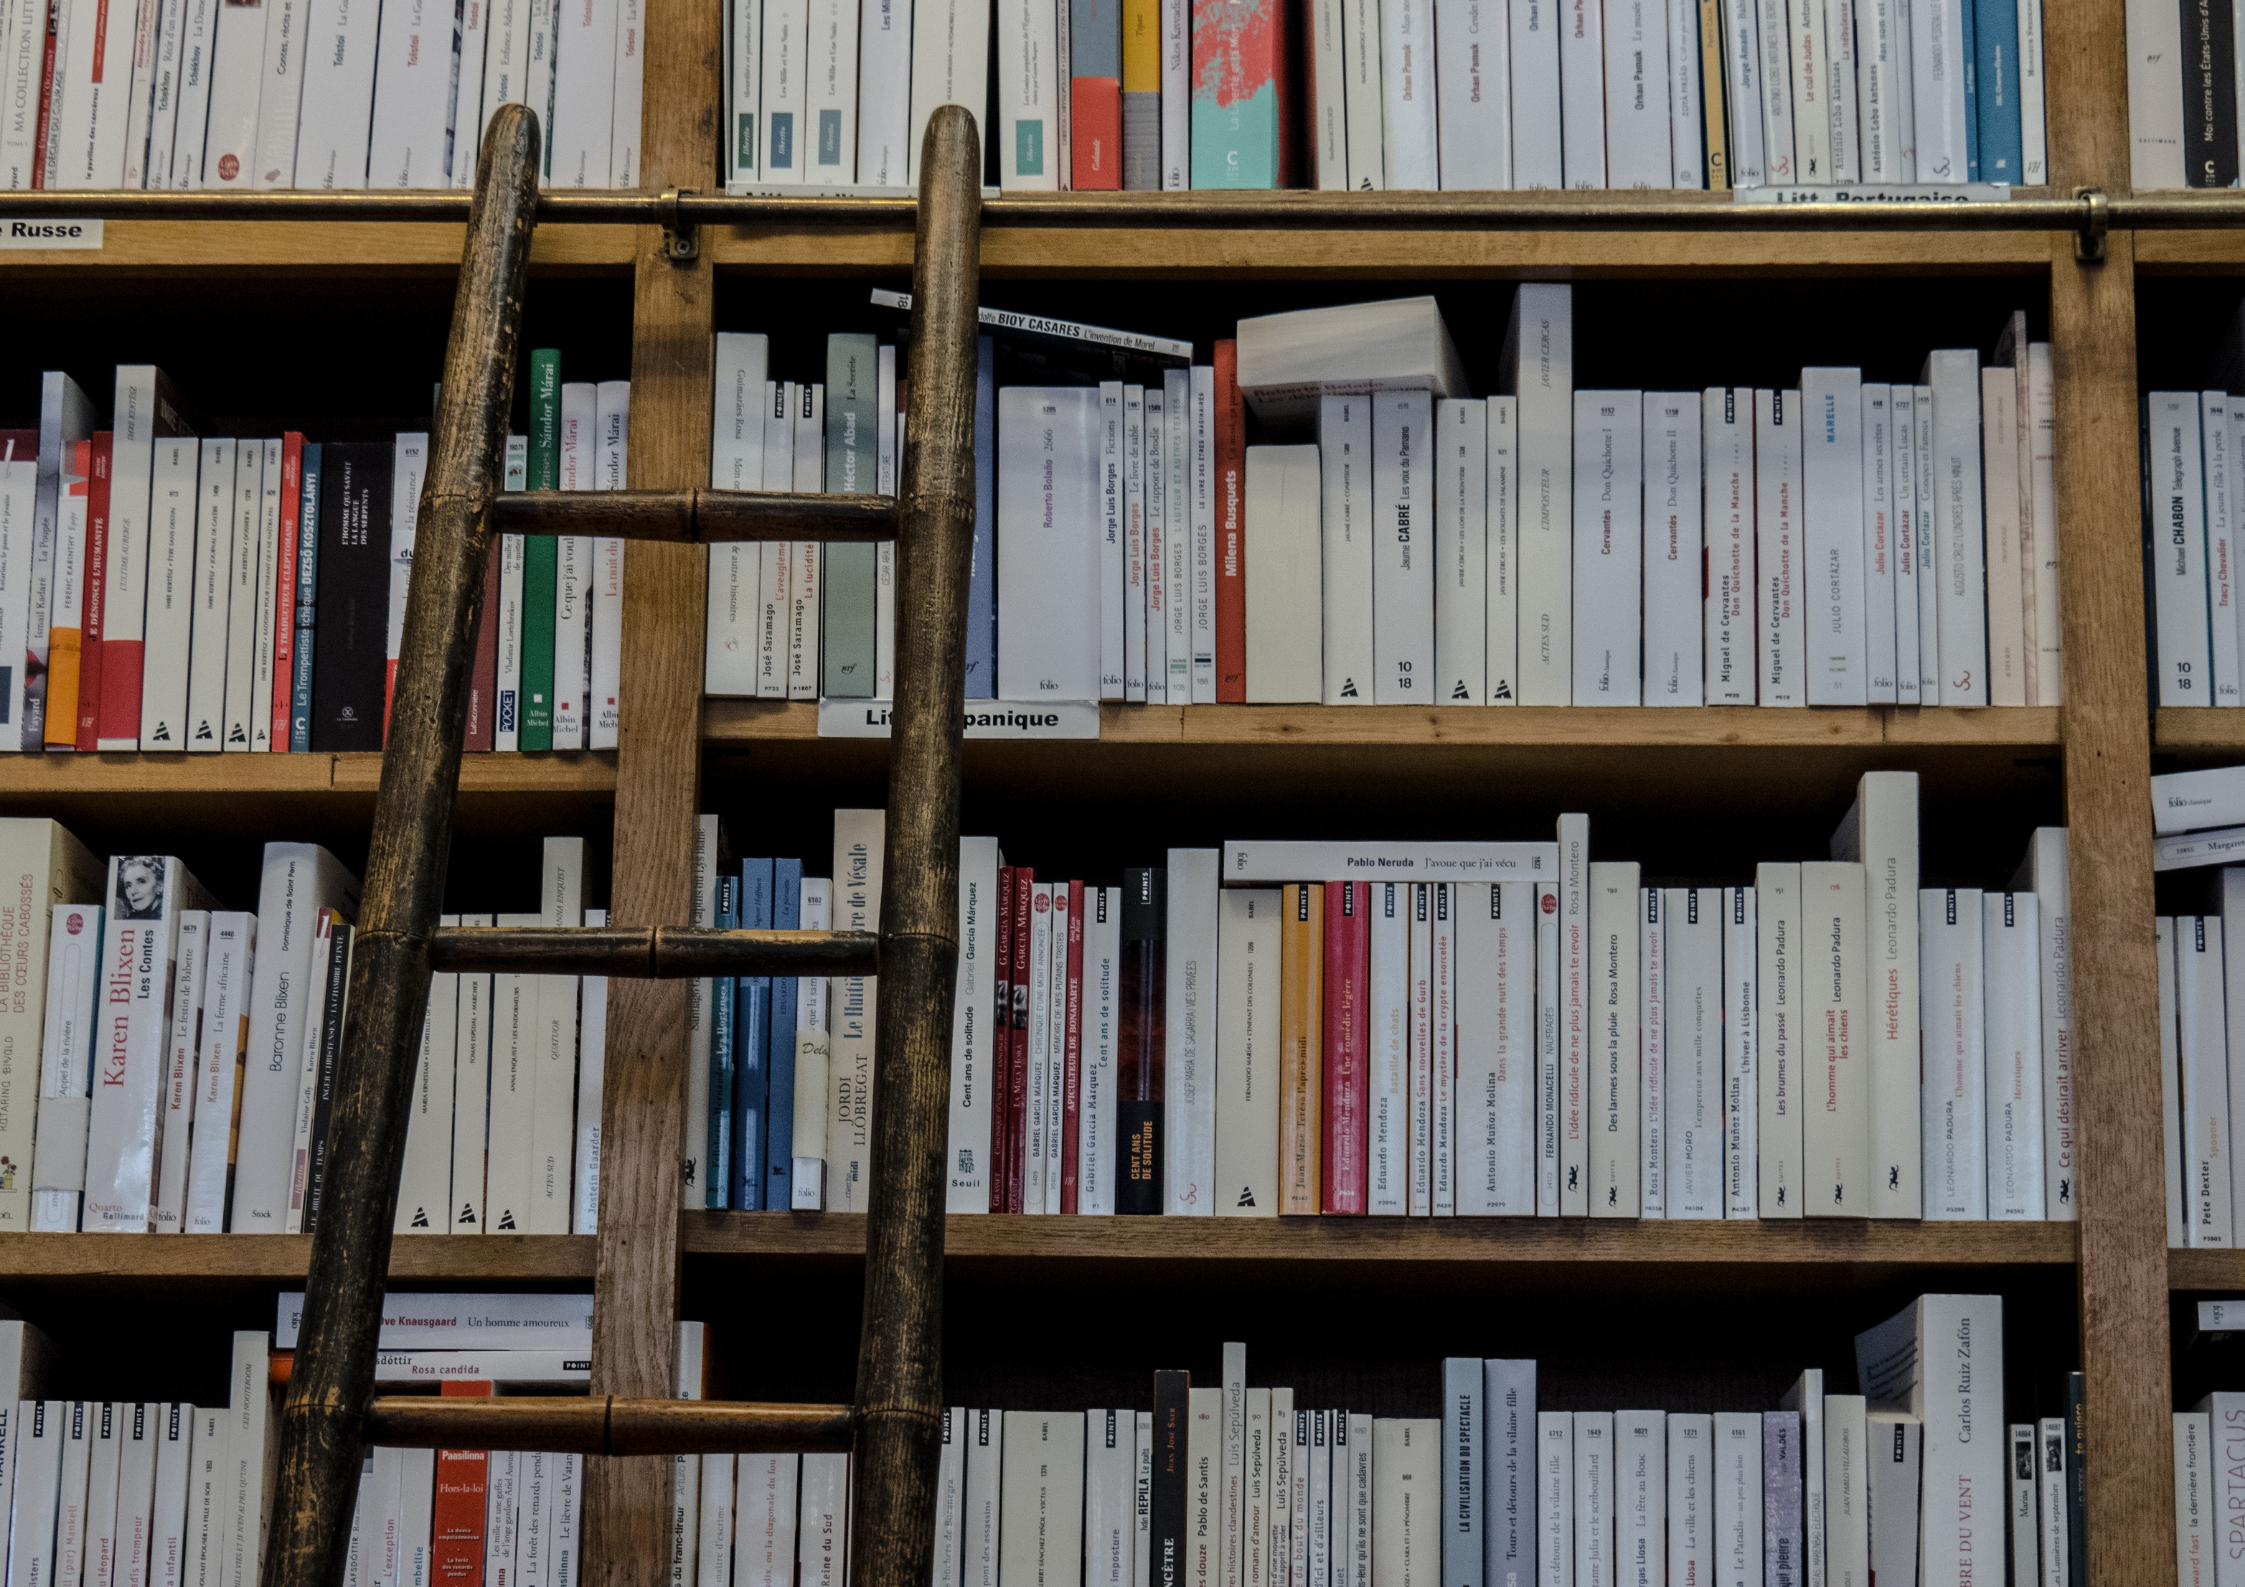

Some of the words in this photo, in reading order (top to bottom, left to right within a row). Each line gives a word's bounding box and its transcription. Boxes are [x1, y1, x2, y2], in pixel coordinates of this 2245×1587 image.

[333, 35, 345, 66] Tolstoï
[407, 35, 419, 66] Tolstoï
[1470, 44, 1479, 73] Pamuk
[1740, 29, 1748, 60] Amado
[1803, 35, 1812, 60] Judas
[2200, 18, 2211, 70] États-Unis
[16, 30, 31, 107] COLLECTION
[1742, 63, 1751, 88] Jorge
[1804, 76, 1813, 90] cul
[1805, 63, 1812, 74] de
[2203, 72, 2211, 87] les
[1471, 76, 1480, 102] Orhan
[1806, 92, 1814, 102] Le
[2204, 89, 2213, 121] contre
[13, 109, 26, 132] MA
[2205, 124, 2213, 141] Moi
[12, 223, 82, 237] Russe
[999, 313, 1025, 328] BIOY
[1028, 318, 1080, 337] CASARES
[1124, 337, 1133, 346] de
[1134, 338, 1155, 351] Morel
[540, 364, 554, 398] Márai
[540, 403, 552, 448] Sándor
[843, 412, 857, 446] Abad
[1825, 395, 1835, 442] MARELLE
[1044, 429, 1053, 451] 2666
[1105, 420, 1115, 454] Fictions
[1399, 426, 1409, 456] Pamano
[843, 448, 857, 492] Héctor
[1401, 458, 1409, 467] du
[1602, 435, 1614, 479] Quichotte
[1043, 459, 1053, 490] Bolaño
[1106, 463, 1117, 495] Borges
[1106, 497, 1115, 515] Luis
[1225, 470, 1239, 529] Busquets
[1400, 486, 1410, 499] Les
[1602, 481, 1611, 501] Don
[303, 473, 316, 547] KOSZTOLÁNYI
[1043, 493, 1053, 528] Roberto
[1396, 505, 1410, 542] CABRÉ
[2172, 497, 2185, 544] CHABON
[39, 517, 51, 548] Poupée
[93, 518, 103, 576] L'HUMANITÉ
[1106, 518, 1117, 544] Jorge
[1601, 509, 1611, 555] Cervantès
[38, 551, 48, 562] La
[284, 520, 293, 581] CLEPTOMANE
[299, 549, 313, 584] DEZSŐ
[1225, 533, 1236, 576] Milena
[1401, 545, 1410, 570] Jaume
[2176, 548, 2186, 575] Michael
[1828, 549, 1840, 601] CORTÁZAR
[36, 578, 46, 609] Kadaré
[90, 580, 100, 625] DÉNONCE
[300, 587, 313, 627] tchèque
[1721, 575, 1729, 626] Cervantes
[34, 611, 45, 638] Ismail
[280, 584, 290, 644] TRADUCTEUR
[763, 604, 775, 651] Saramago
[1831, 606, 1841, 633] JULIO
[1721, 631, 1729, 643] de
[278, 648, 287, 661] LE
[298, 629, 312, 691] Trompettiste
[763, 655, 772, 676] José
[1721, 647, 1732, 682] Miguel
[29, 698, 42, 731] Fayard
[297, 693, 307, 706] Le
[501, 691, 513, 731] POCKET
[963, 709, 1058, 731] panique
[847, 844, 867, 887] Vésale
[1347, 857, 1375, 866] Pablo
[1378, 858, 1414, 866] Neruda
[1425, 858, 1457, 868] J'avoue
[1459, 861, 1476, 870] que
[1479, 858, 1492, 869] j'ai
[1495, 859, 1516, 867] vécu
[1569, 841, 1579, 887] Montero
[1885, 857, 1896, 899] Padura
[18, 874, 33, 937] CABOSSÉS
[848, 892, 865, 907] de
[967, 882, 977, 925] Márquez
[1569, 891, 1579, 915] Rosa
[966, 928, 975, 960] García
[1570, 924, 1579, 955] revoir
[1885, 903, 1897, 959] Leonardo
[15, 941, 29, 986] CŒURS
[110, 930, 135, 1003] Blixen
[139, 930, 154, 973] Contes
[1570, 959, 1579, 968] te
[1609, 934, 1617, 979] Montero
[137, 978, 150, 999] Les
[274, 972, 289, 1009] Blixen
[965, 963, 974, 995] Gabriel
[1569, 971, 1582, 1007] jamais
[1608, 982, 1618, 1005] Rosa
[13, 991, 26, 1013] DES
[1886, 969, 1901, 1040] Hérétiques
[965, 1006, 973, 1045] solitude
[1569, 1009, 1581, 1032] plus
[1608, 1012, 1620, 1037] pluie
[104, 1017, 128, 1086] Karen
[269, 1013, 286, 1072] Baronne
[964, 1048, 972, 1061] de
[1569, 1051, 1579, 1064] de
[1571, 1035, 1579, 1048] ne
[1608, 1040, 1617, 1049] la
[839, 1078, 853, 1125] JORDI
[854, 1053, 868, 1146] LLOBREGAT
[962, 1084, 971, 1108] Cent
[1569, 1067, 1579, 1107] ridicule
[1608, 1077, 1617, 1111] larmes
[1569, 1110, 1579, 1139] L'idée
[1608, 1114, 1617, 1132] Des
[1132, 1134, 1141, 1153] ANS
[1143, 1121, 1152, 1162] SOLITUDE
[1131, 1156, 1140, 1179] CENT
[1142, 1168, 1151, 1179] DE
[2201, 1161, 2210, 1196] Dexter
[2202, 1202, 2211, 1224] Pete
[399, 1316, 457, 1328] Knausgaard
[468, 1317, 482, 1326] Un
[485, 1317, 520, 1327] homme
[523, 1319, 569, 1327] amoureux
[1957, 1318, 1970, 1358] Zafón
[412, 1365, 435, 1374] Rosa
[440, 1365, 479, 1374] candida
[1958, 1363, 1970, 1393] Ruiz
[1229, 1382, 1243, 1441] Sepúlveda
[1460, 1395, 1470, 1443] SPECTACLE
[1958, 1398, 1971, 1443] Carlos
[1140, 1448, 1151, 1464] puits
[1229, 1444, 1240, 1466] Luis
[1460, 1446, 1470, 1457] DU
[2187, 1424, 2196, 1468] frontière
[1141, 1466, 1149, 1474] Le
[1198, 1457, 1208, 1489] Santis
[2225, 1408, 2245, 1559] SPARTACUS
[1137, 1478, 1149, 1515] REPILA
[1198, 1492, 1208, 1505] de
[1459, 1460, 1470, 1519] CIVILISATION
[2189, 1471, 2198, 1515] dernière
[1197, 1507, 1207, 1536] Pablo
[1459, 1522, 1470, 1532] LA
[2189, 1518, 2198, 1527] la
[383, 1519, 395, 1577] L'exception
